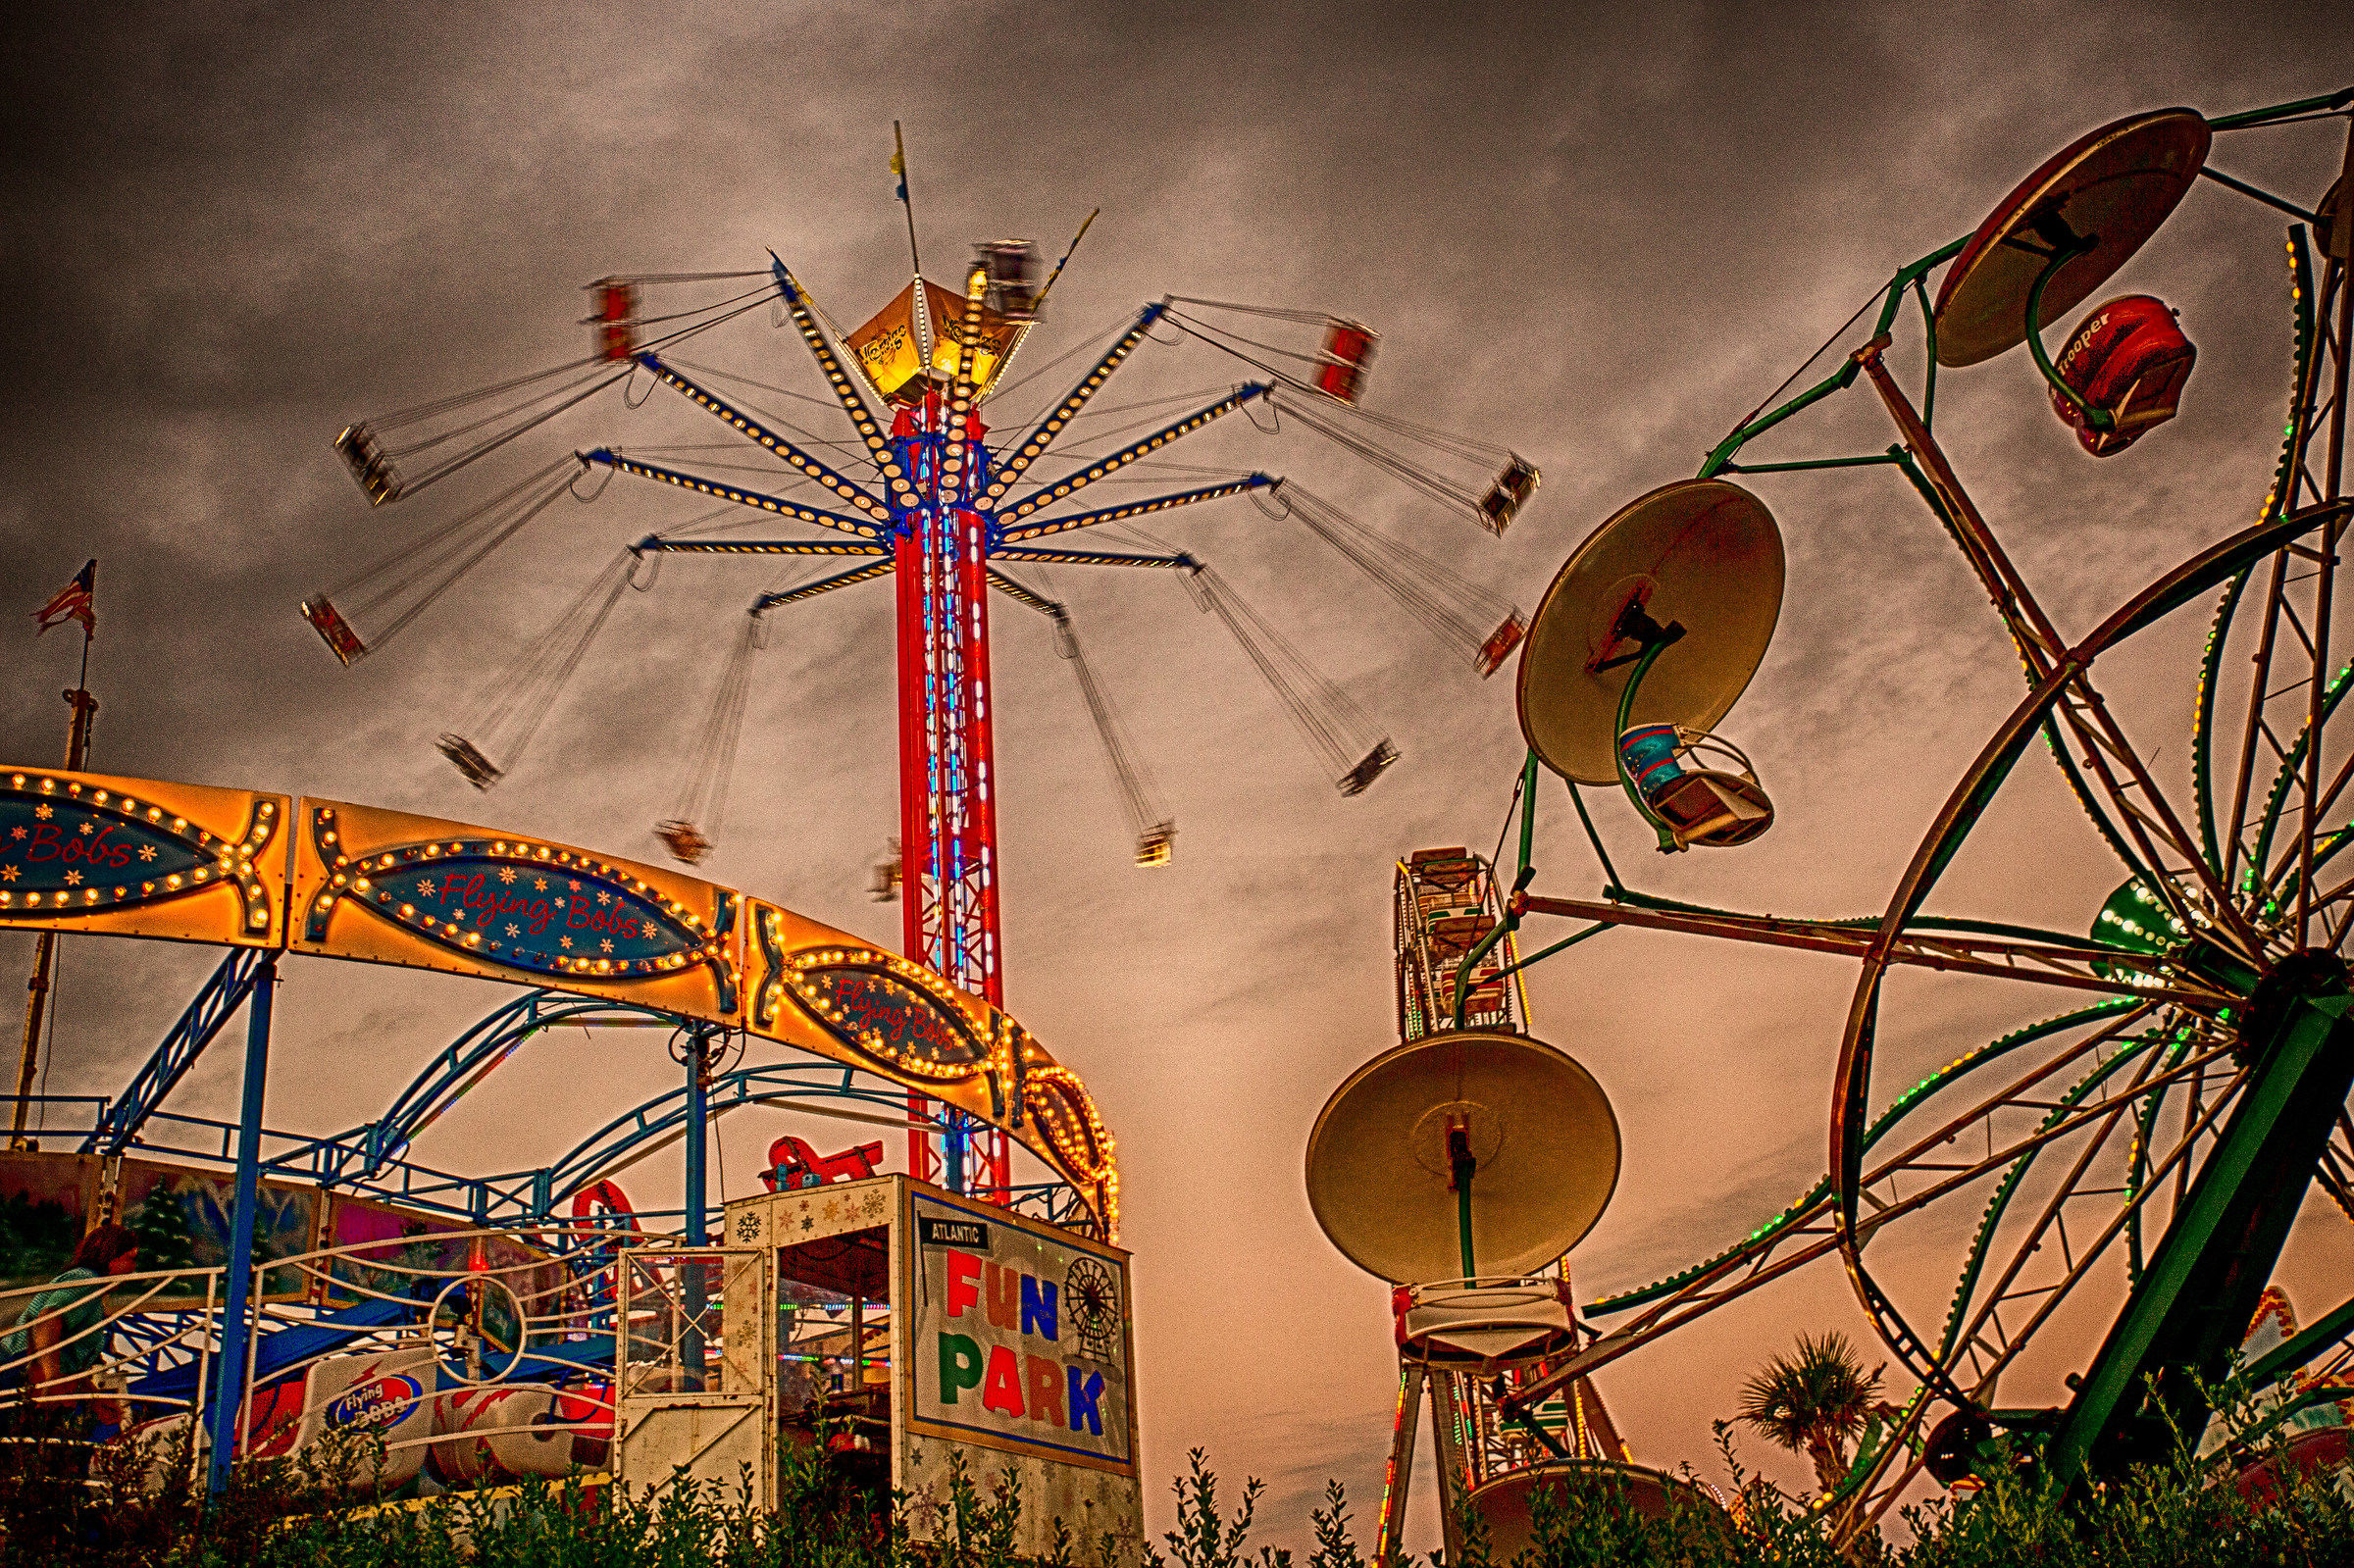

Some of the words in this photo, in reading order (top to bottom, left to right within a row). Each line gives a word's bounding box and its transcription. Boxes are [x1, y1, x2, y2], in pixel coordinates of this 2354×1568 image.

[2058, 313, 2110, 376] Trooper
[26, 824, 133, 868] Bobs
[438, 873, 558, 936] Flying
[566, 894, 639, 938] Bobs
[835, 978, 908, 1040] Flying
[911, 1007, 952, 1050] Bobs
[932, 1222, 979, 1244] ATLANTIC
[947, 1248, 1058, 1341] FUN
[345, 1383, 384, 1412] Flying
[938, 1331, 1105, 1436] PARK
